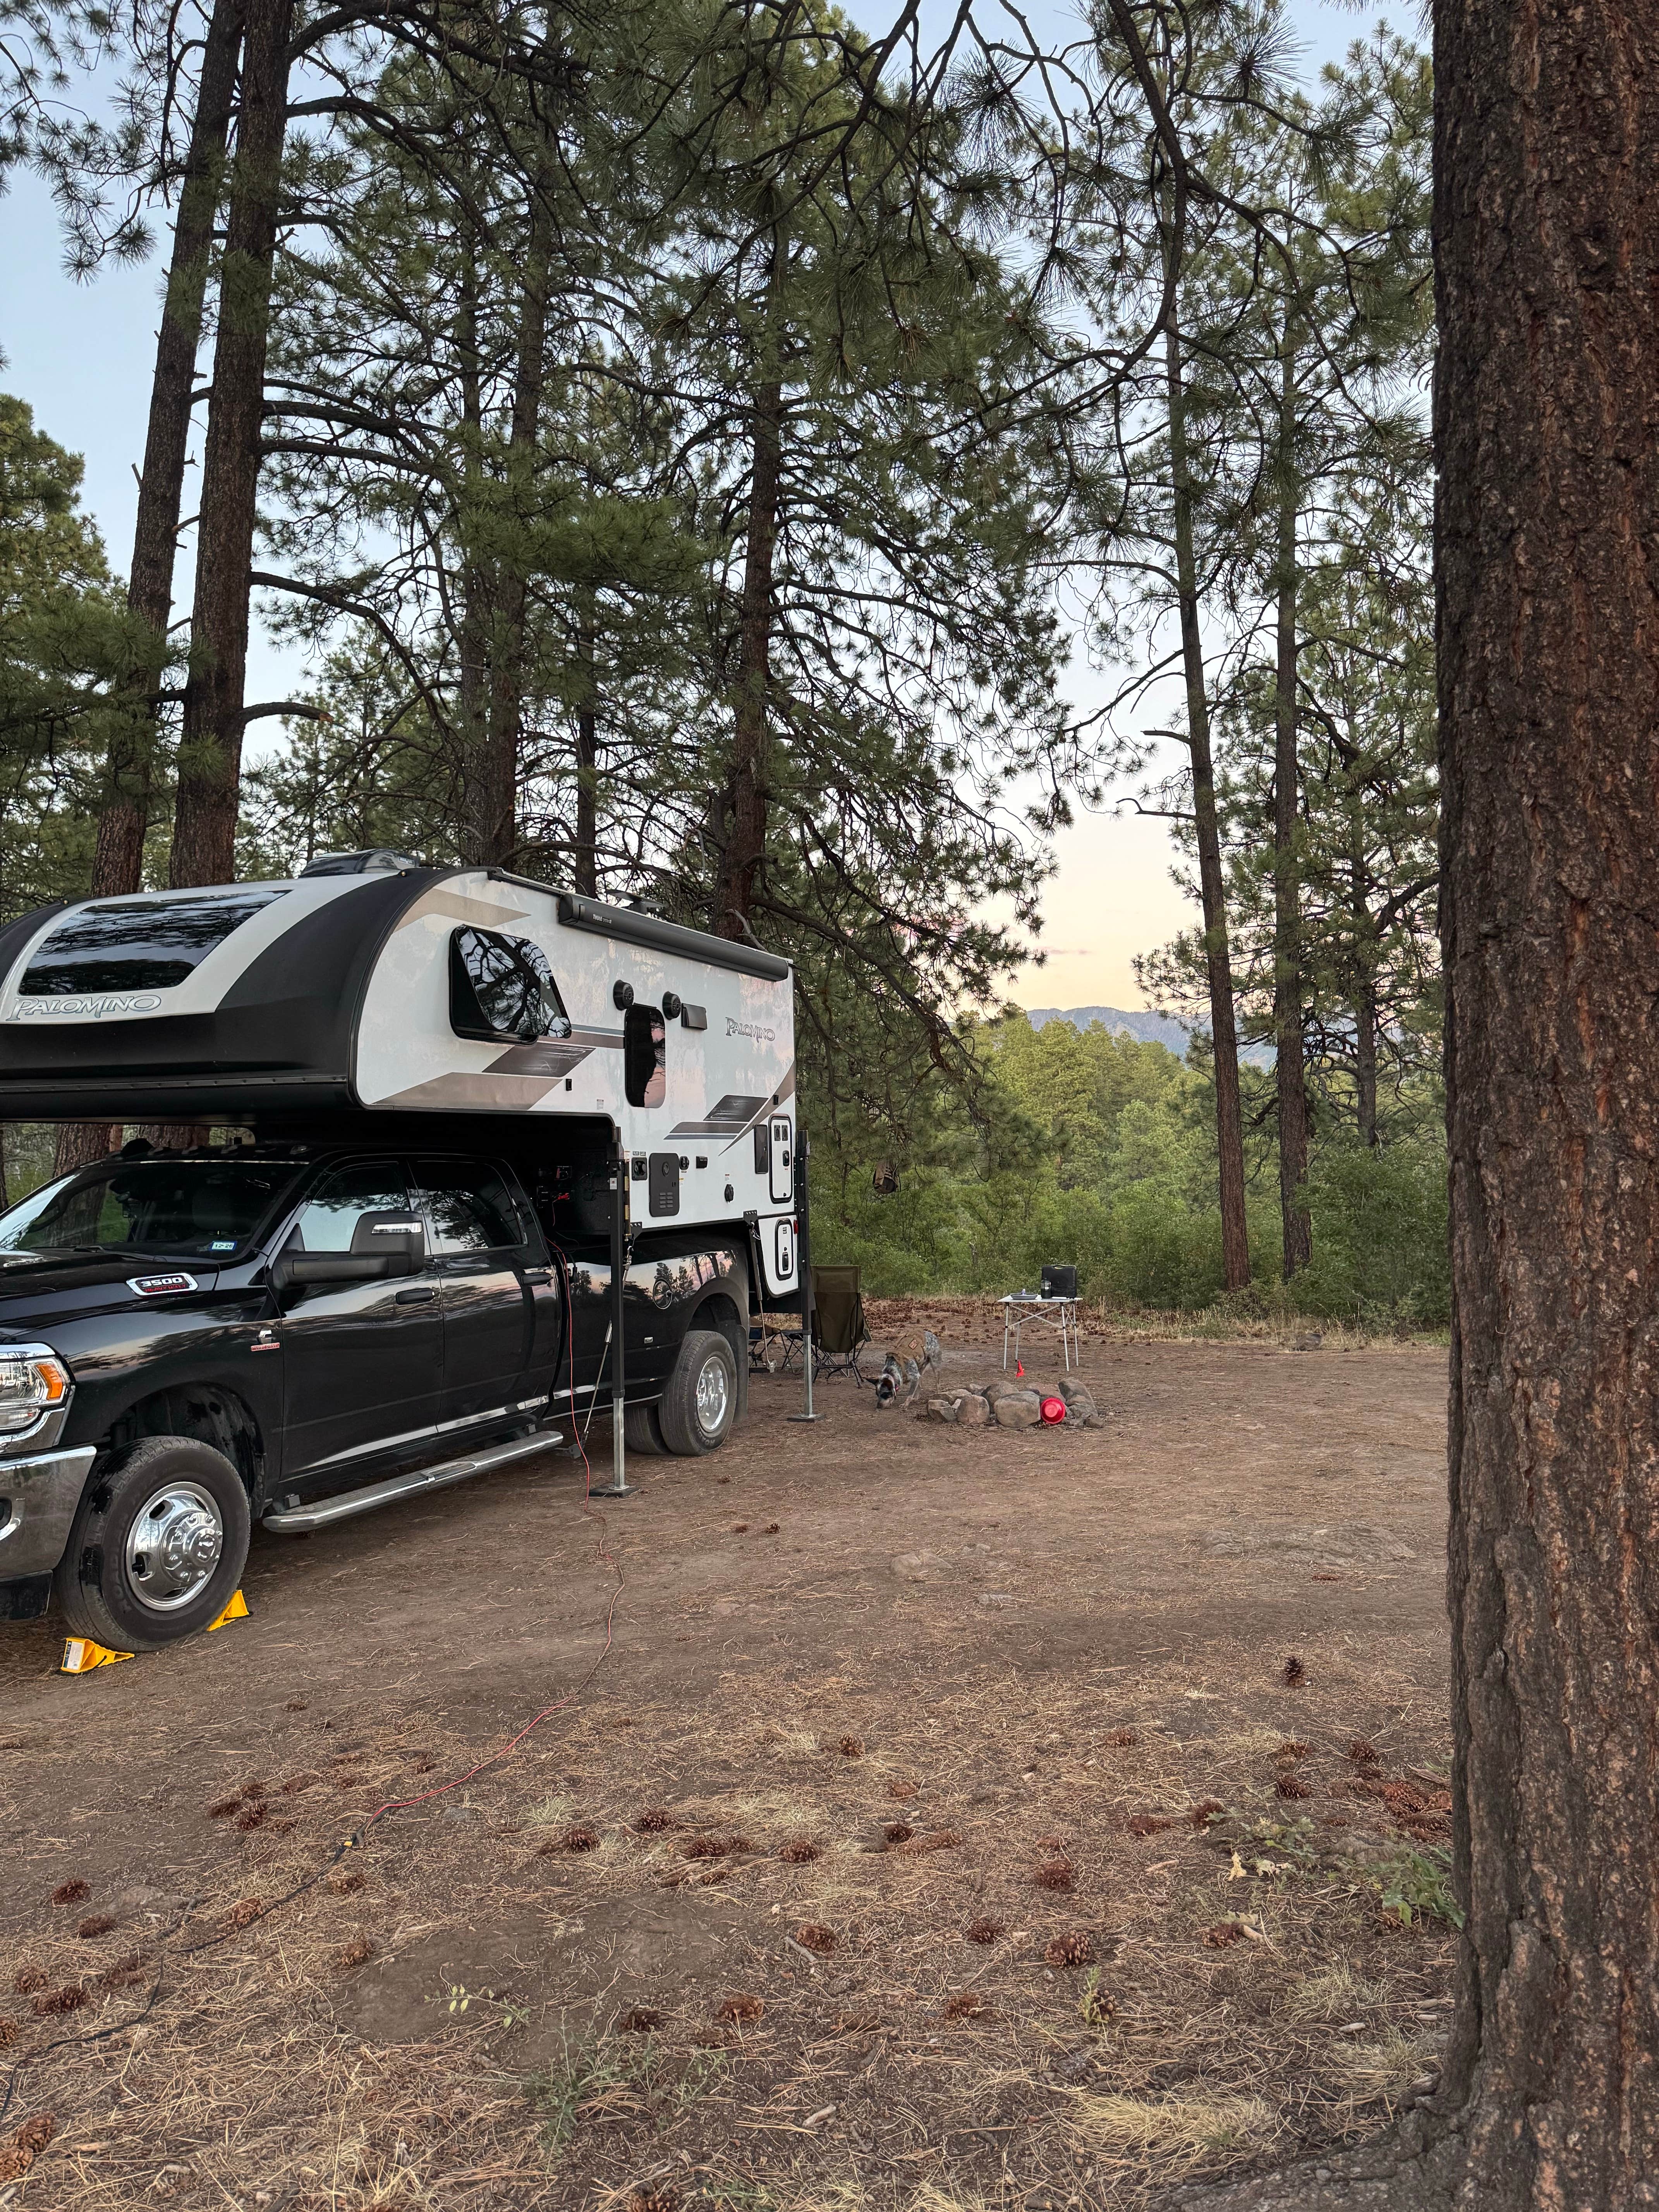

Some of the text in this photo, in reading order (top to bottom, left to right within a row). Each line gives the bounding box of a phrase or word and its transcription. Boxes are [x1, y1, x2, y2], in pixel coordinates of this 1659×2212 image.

[5, 994, 161, 1021] PALOMINO
[725, 1017, 775, 1043] PALOMINO
[140, 1277, 183, 1287] 3500
